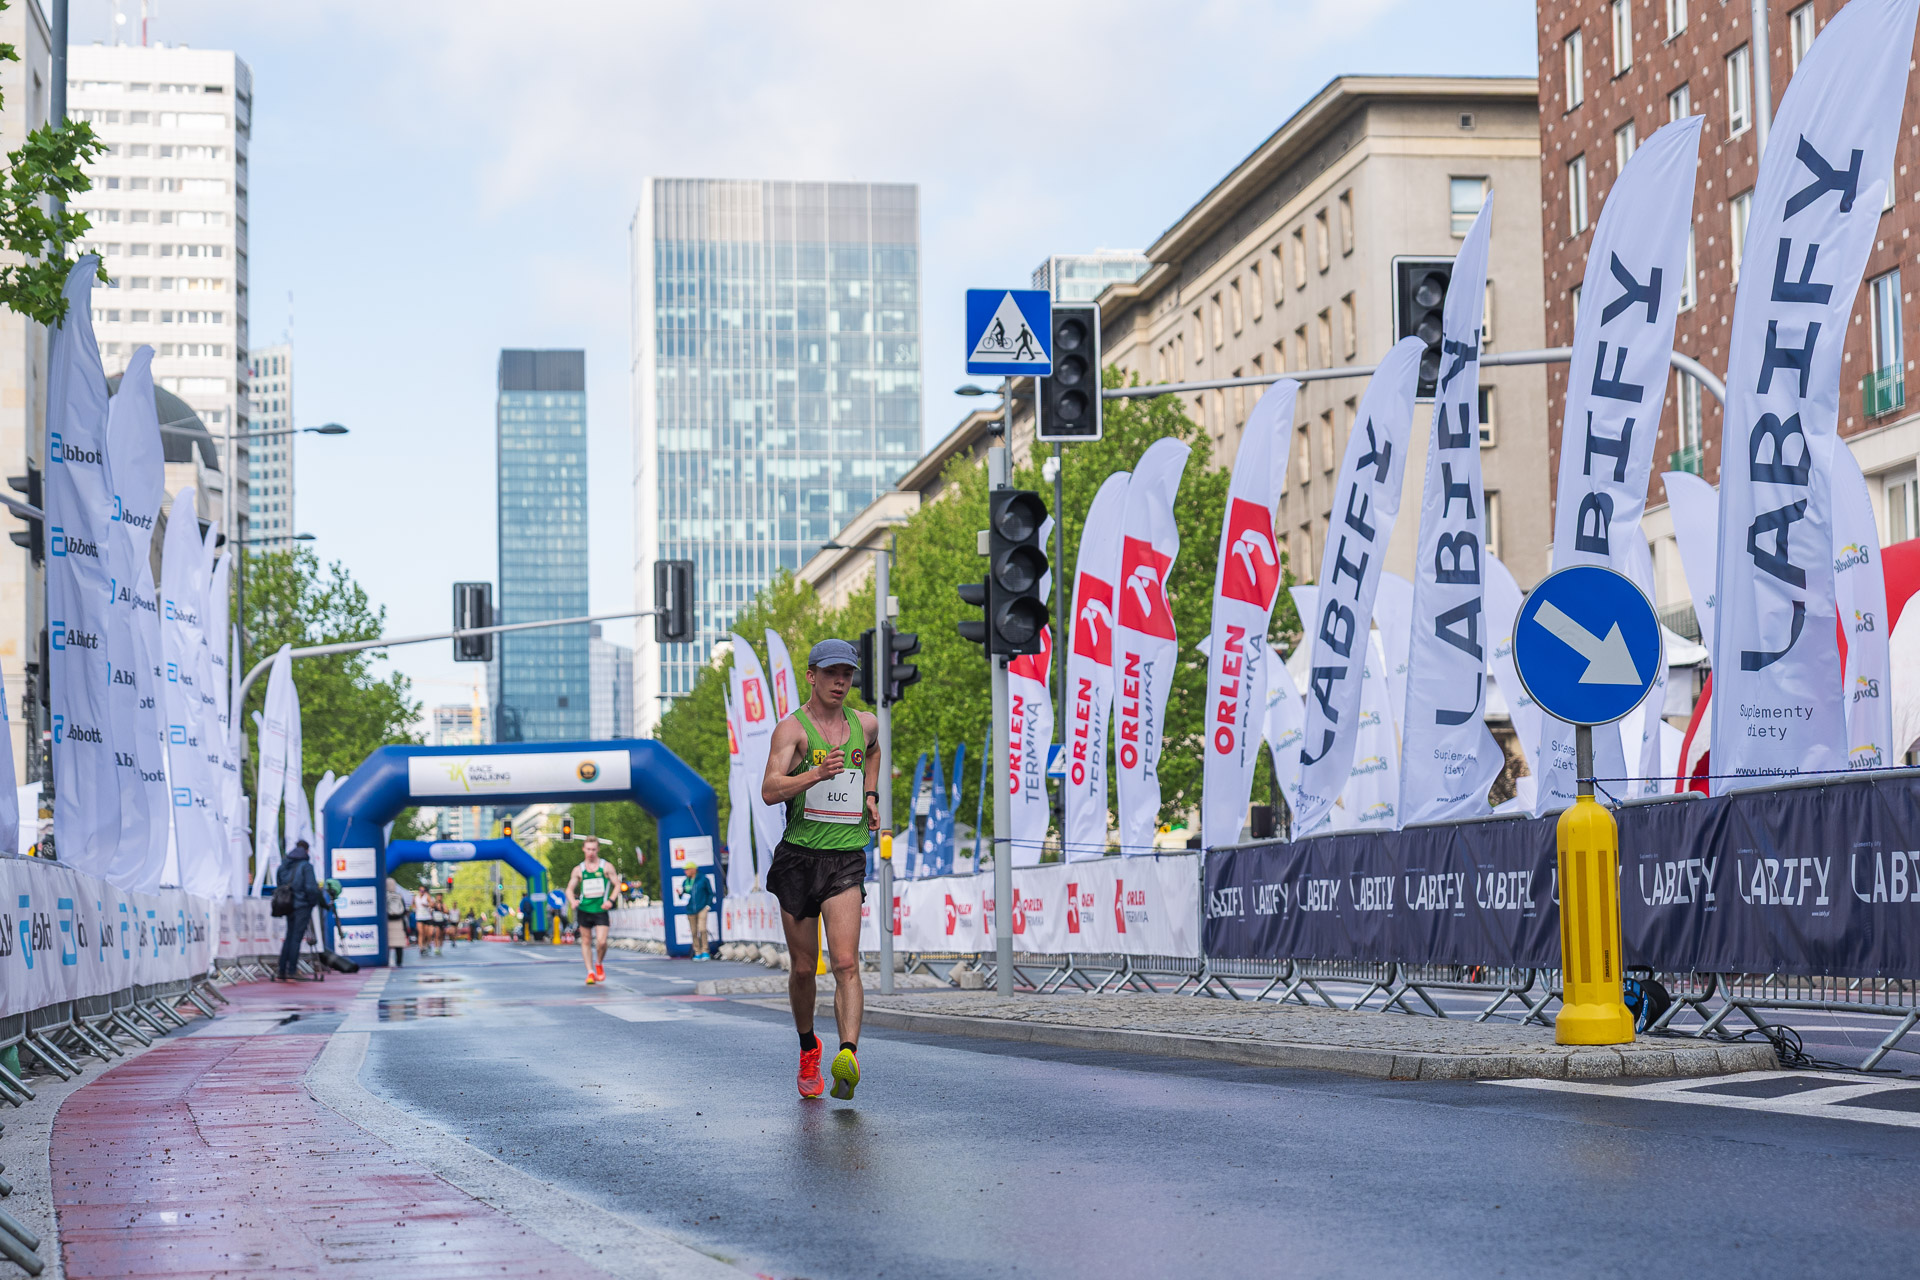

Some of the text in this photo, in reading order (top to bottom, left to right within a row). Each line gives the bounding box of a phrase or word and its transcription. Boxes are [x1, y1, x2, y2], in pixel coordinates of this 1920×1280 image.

[1574, 250, 1663, 556] BIFY
[1741, 133, 1864, 672] LABIFY
[1434, 327, 1484, 726] LABIFY
[1300, 415, 1393, 767] LABIFY
[1120, 651, 1140, 770] ORLEN
[1214, 624, 1245, 755] ORLEN
[1740, 703, 1814, 721] Suplementy
[1009, 694, 1024, 795] ORLEN
[1025, 702, 1042, 804] TERMIKA
[1071, 677, 1092, 786] ORLEN
[1747, 722, 1788, 740] diety
[850, 772, 856, 784] 7
[1553, 757, 1577, 771] diet
[828, 792, 848, 803] ŁUC
[1126, 890, 1146, 906] ORLEN
[1252, 882, 1289, 916] LABIFY
[1350, 875, 1396, 911] LABIFY
[1405, 872, 1465, 911] LABIFY
[1476, 869, 1535, 910] LABIFY
[1639, 856, 1718, 906] LABIFY
[1737, 856, 1831, 906] LABIFY
[1023, 898, 1044, 912] ORLEN
